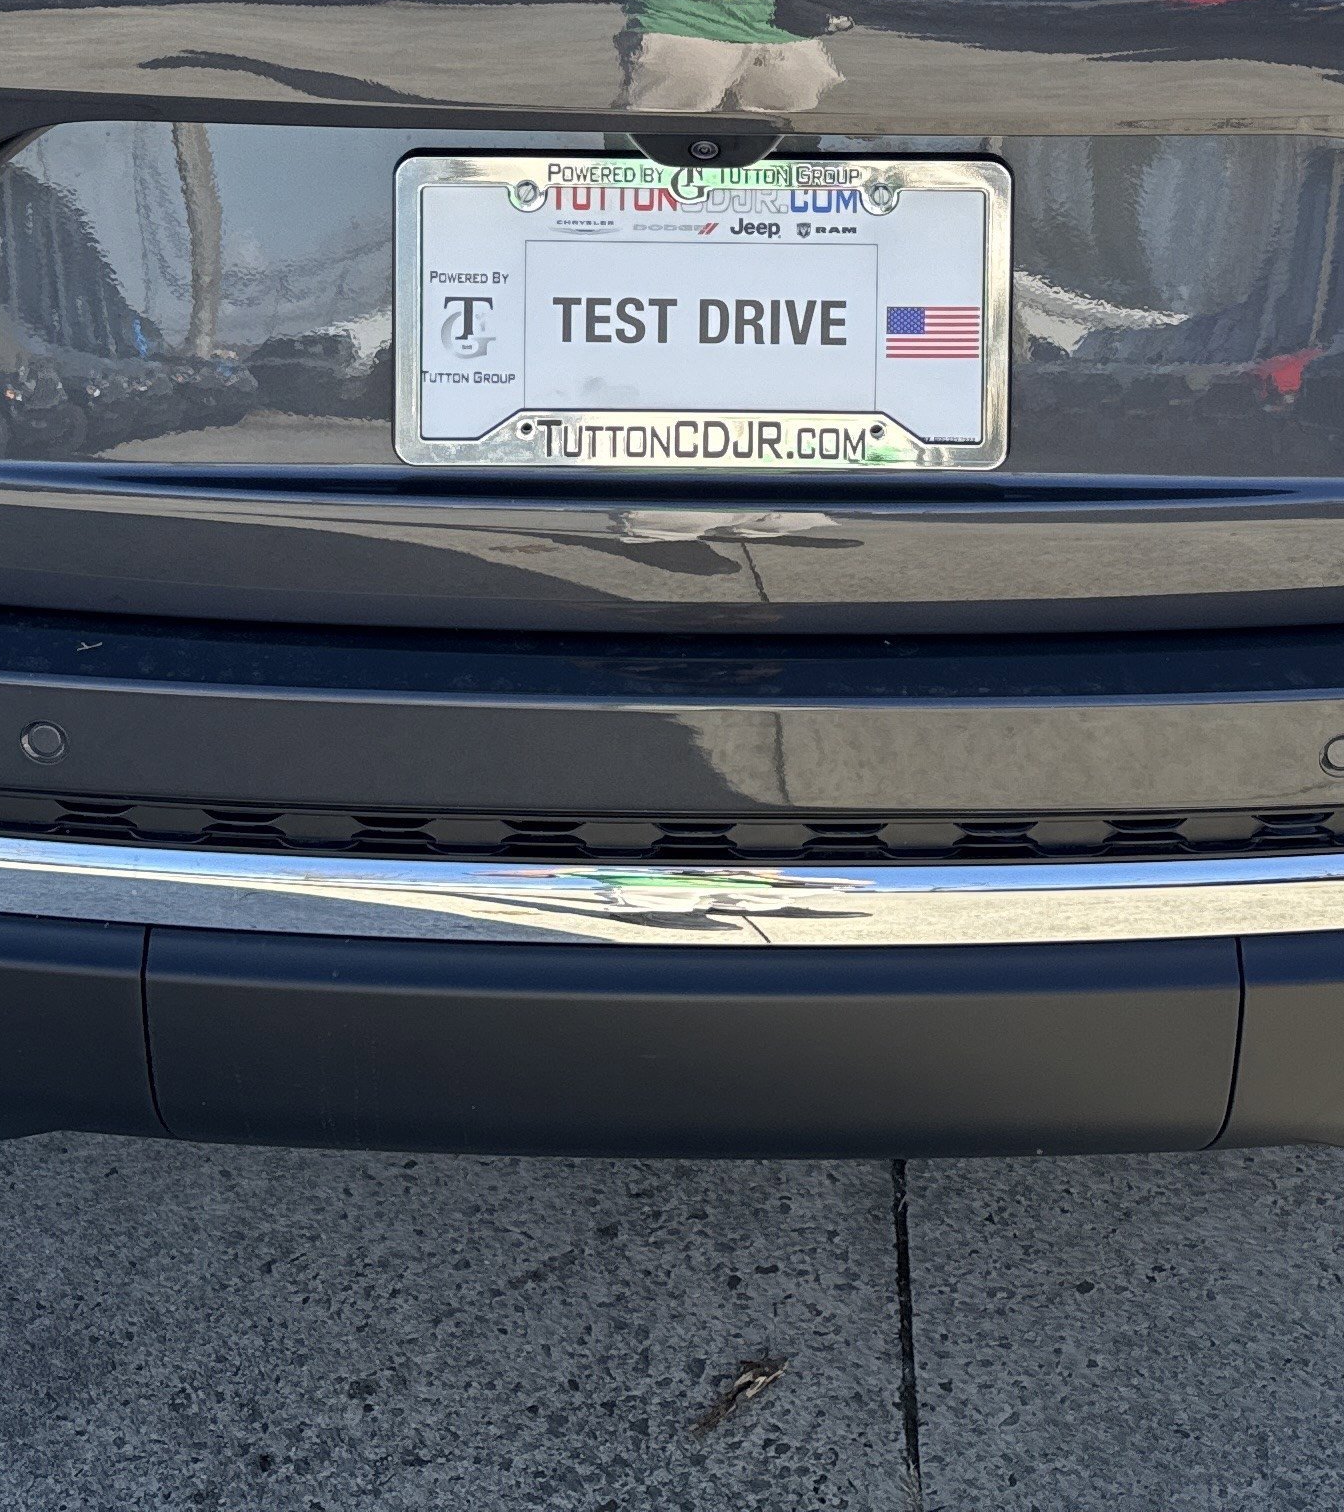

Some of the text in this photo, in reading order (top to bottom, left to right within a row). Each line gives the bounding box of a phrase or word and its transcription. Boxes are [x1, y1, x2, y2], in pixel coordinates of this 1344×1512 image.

[548, 163, 636, 183] POWERED
[643, 167, 664, 183] BY
[796, 164, 861, 185] GROUP
[633, 223, 703, 232] DODGE
[730, 217, 781, 238] Jeep
[816, 226, 857, 234] RAM
[430, 270, 488, 284] POWERED
[552, 297, 847, 346] TEST DRIVE
[421, 371, 516, 384] TUTTON GROUP
